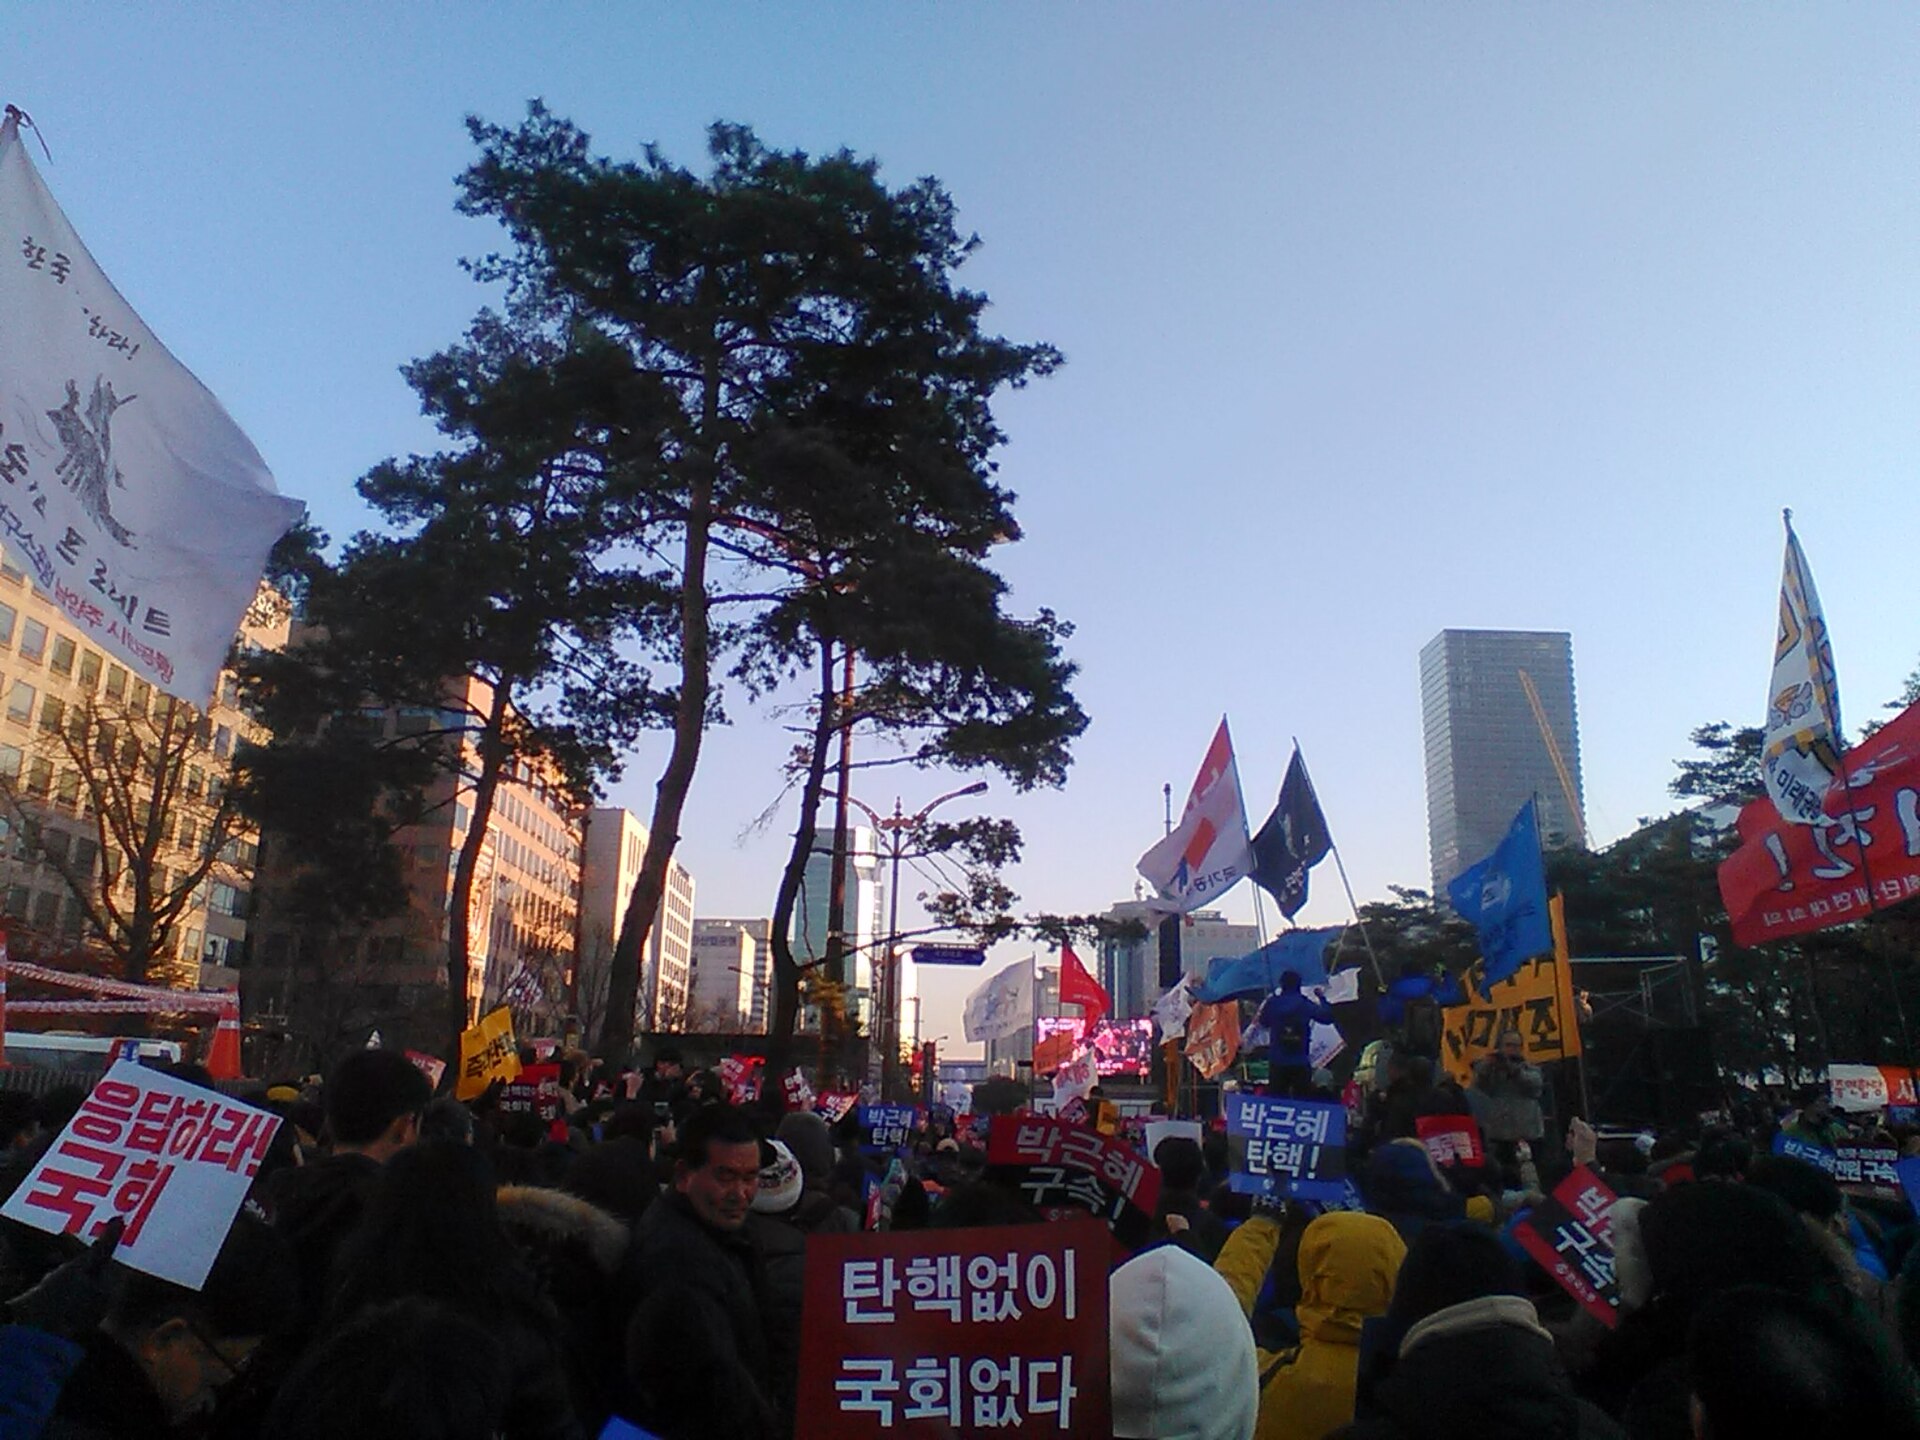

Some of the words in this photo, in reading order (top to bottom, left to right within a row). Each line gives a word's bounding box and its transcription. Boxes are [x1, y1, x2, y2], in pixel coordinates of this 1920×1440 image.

[72, 1081, 279, 1177] 응답하라!
[868, 1108, 913, 1129] 박근혜
[1240, 1102, 1329, 1144] 박근혜
[24, 1141, 175, 1247] 국회
[1016, 1125, 1145, 1200] 박근혜
[1247, 1140, 1321, 1180] 탄핵!
[842, 1249, 1076, 1323] 탄핵없이
[834, 1355, 1078, 1430] 국회없다
